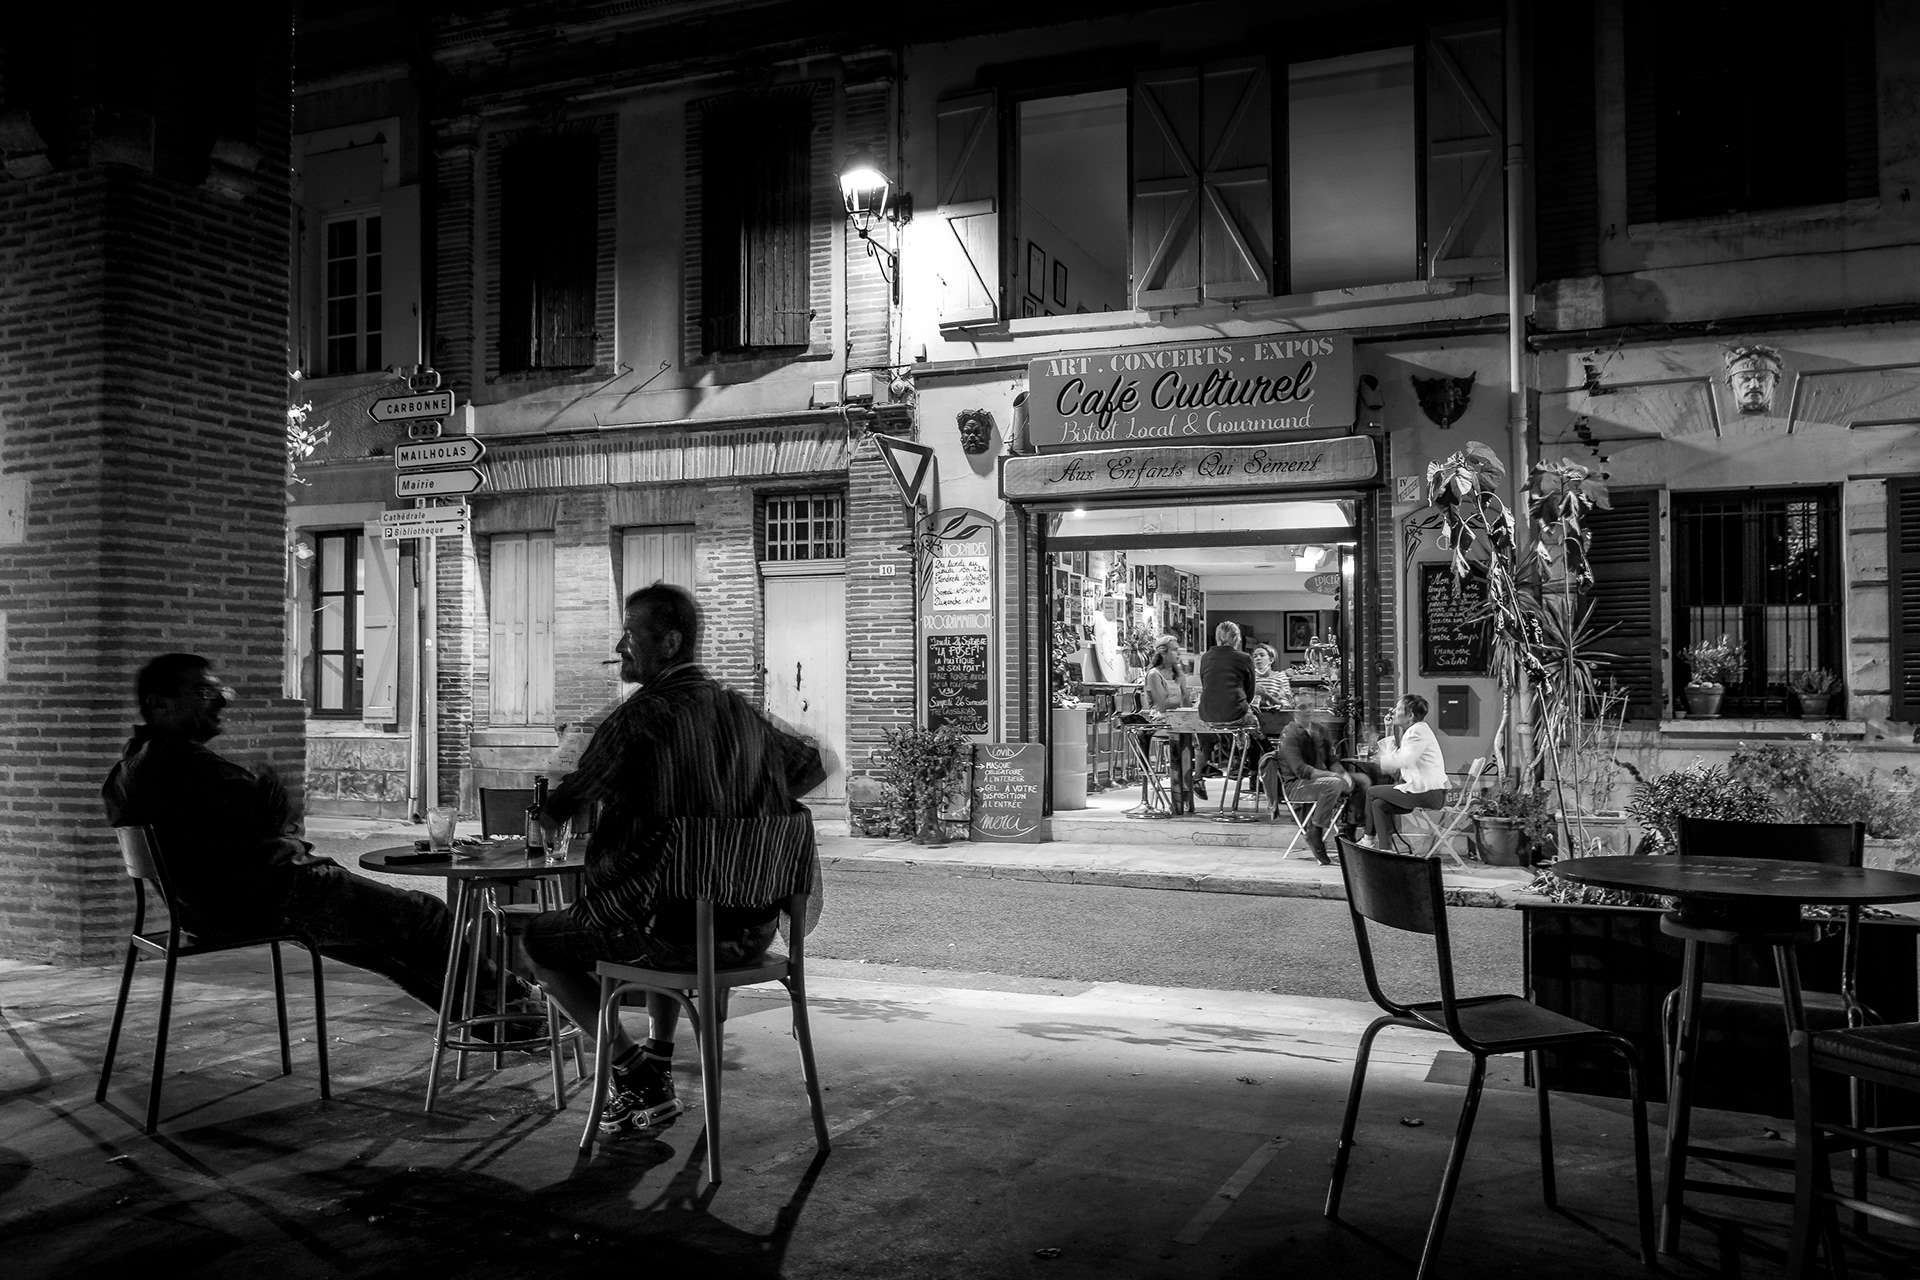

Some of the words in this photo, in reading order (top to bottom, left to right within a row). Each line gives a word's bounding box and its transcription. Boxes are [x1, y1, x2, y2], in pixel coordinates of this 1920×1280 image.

[1045, 357, 1092, 377] ART
[1110, 346, 1232, 372] CONCERTS
[1254, 337, 1334, 361] EXPOS
[1056, 375, 1141, 431] Café
[1151, 360, 1317, 411] Culturel
[387, 399, 447, 414] CARBONNE
[1057, 420, 1119, 443] Bistrot
[1123, 414, 1178, 438] Local
[1182, 412, 1200, 435] &
[1206, 404, 1314, 434] Gourmand
[401, 446, 467, 461] MAILHOLAS
[1049, 457, 1095, 483] Aux
[1106, 456, 1186, 489] Enfants
[1197, 451, 1236, 478] Qui
[1243, 449, 1324, 475] Sèment
[401, 478, 435, 491] Mairie
[383, 510, 426, 522] Cathédrale
[394, 526, 444, 537] Bibliothèque
[943, 542, 987, 557] HORAIRES
[882, 565, 893, 575] 10
[924, 613, 991, 630] PROGRAMMATION
[985, 761, 1012, 770] MASQUE
[982, 792, 1027, 801] DISPOSITION
[1012, 784, 1038, 794] VOTRE
